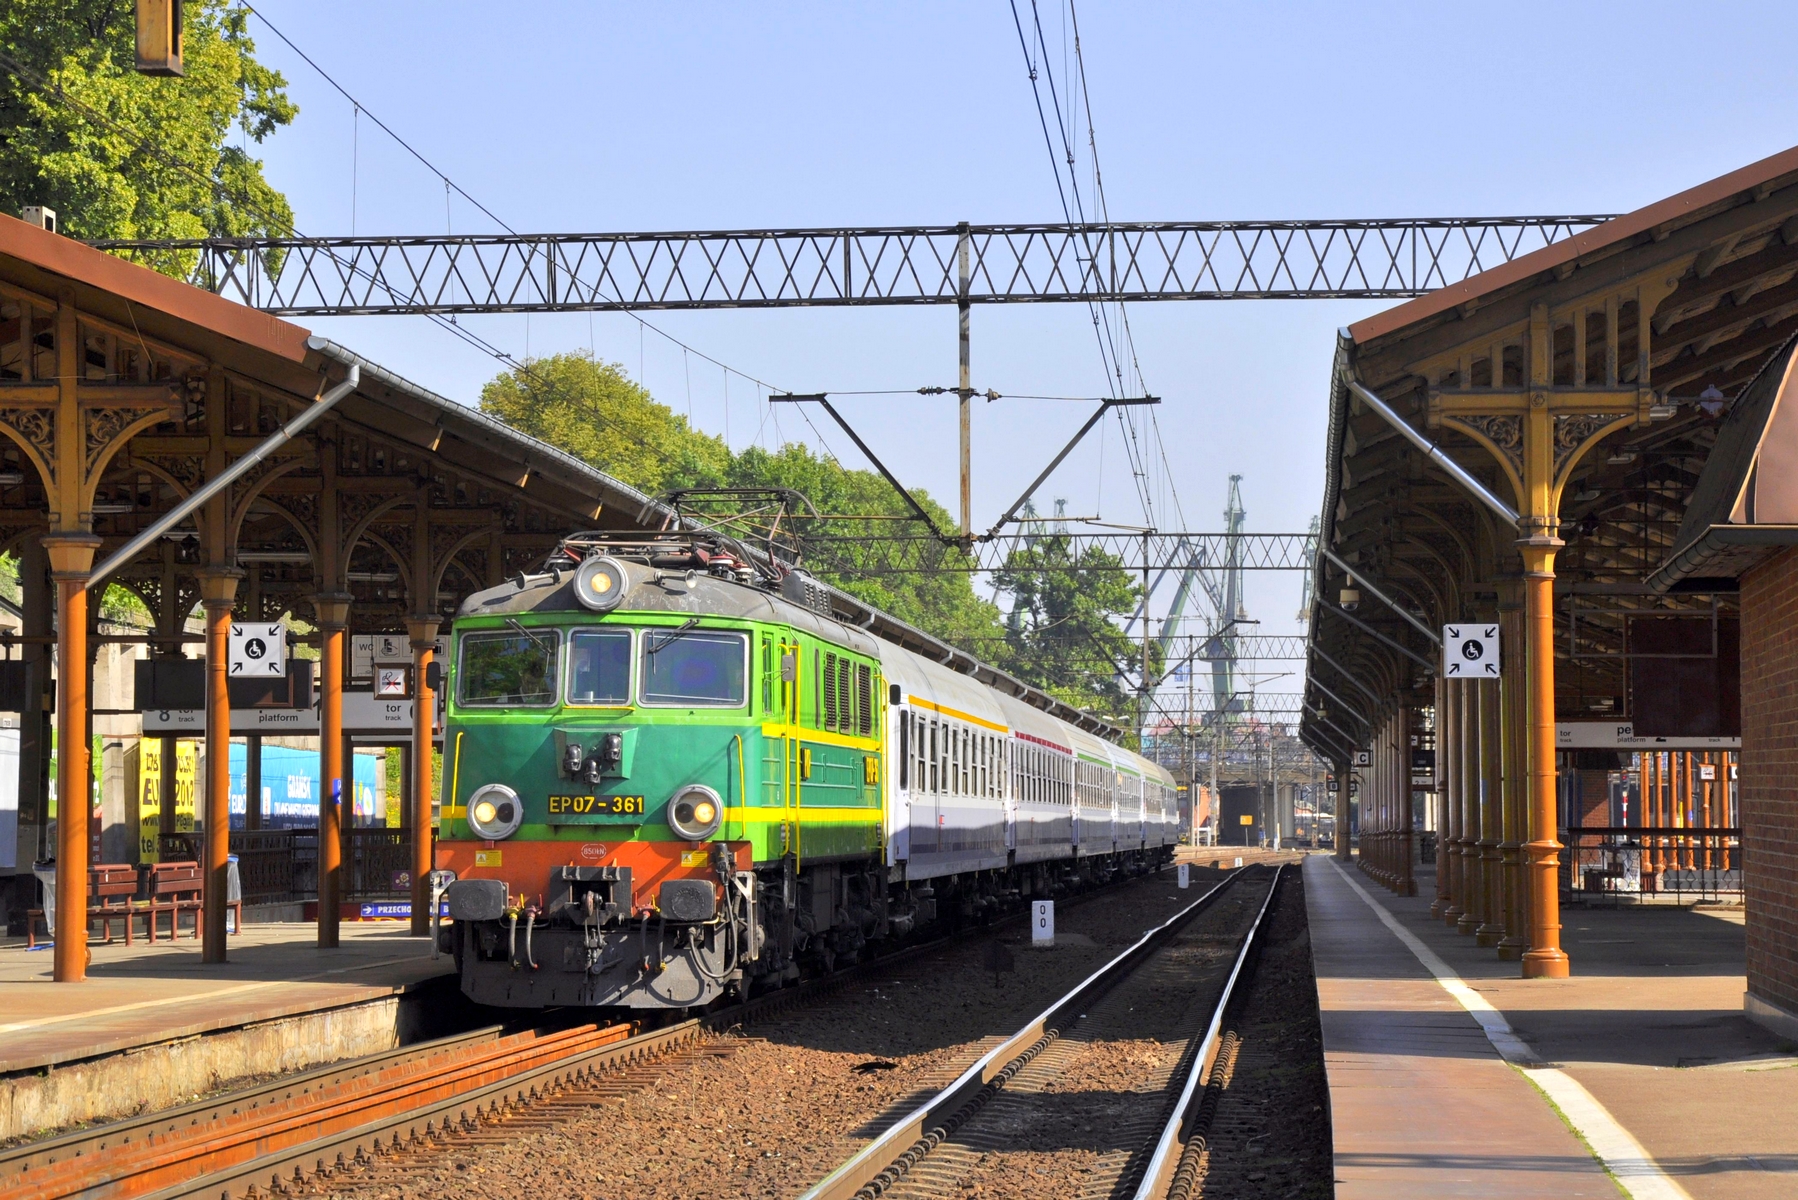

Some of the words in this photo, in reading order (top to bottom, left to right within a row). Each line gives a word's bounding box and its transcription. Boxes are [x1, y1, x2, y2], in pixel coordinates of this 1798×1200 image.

[359, 643, 374, 651] WC
[385, 703, 402, 713] tor
[258, 713, 299, 724] platform
[1617, 735, 1646, 743] platform
[1359, 753, 1367, 763] C
[549, 796, 595, 813] EP07
[612, 796, 644, 813] 361
[377, 905, 411, 914] PRZECHO
[1039, 904, 1046, 915] 0
[1040, 917, 1047, 928] 0
